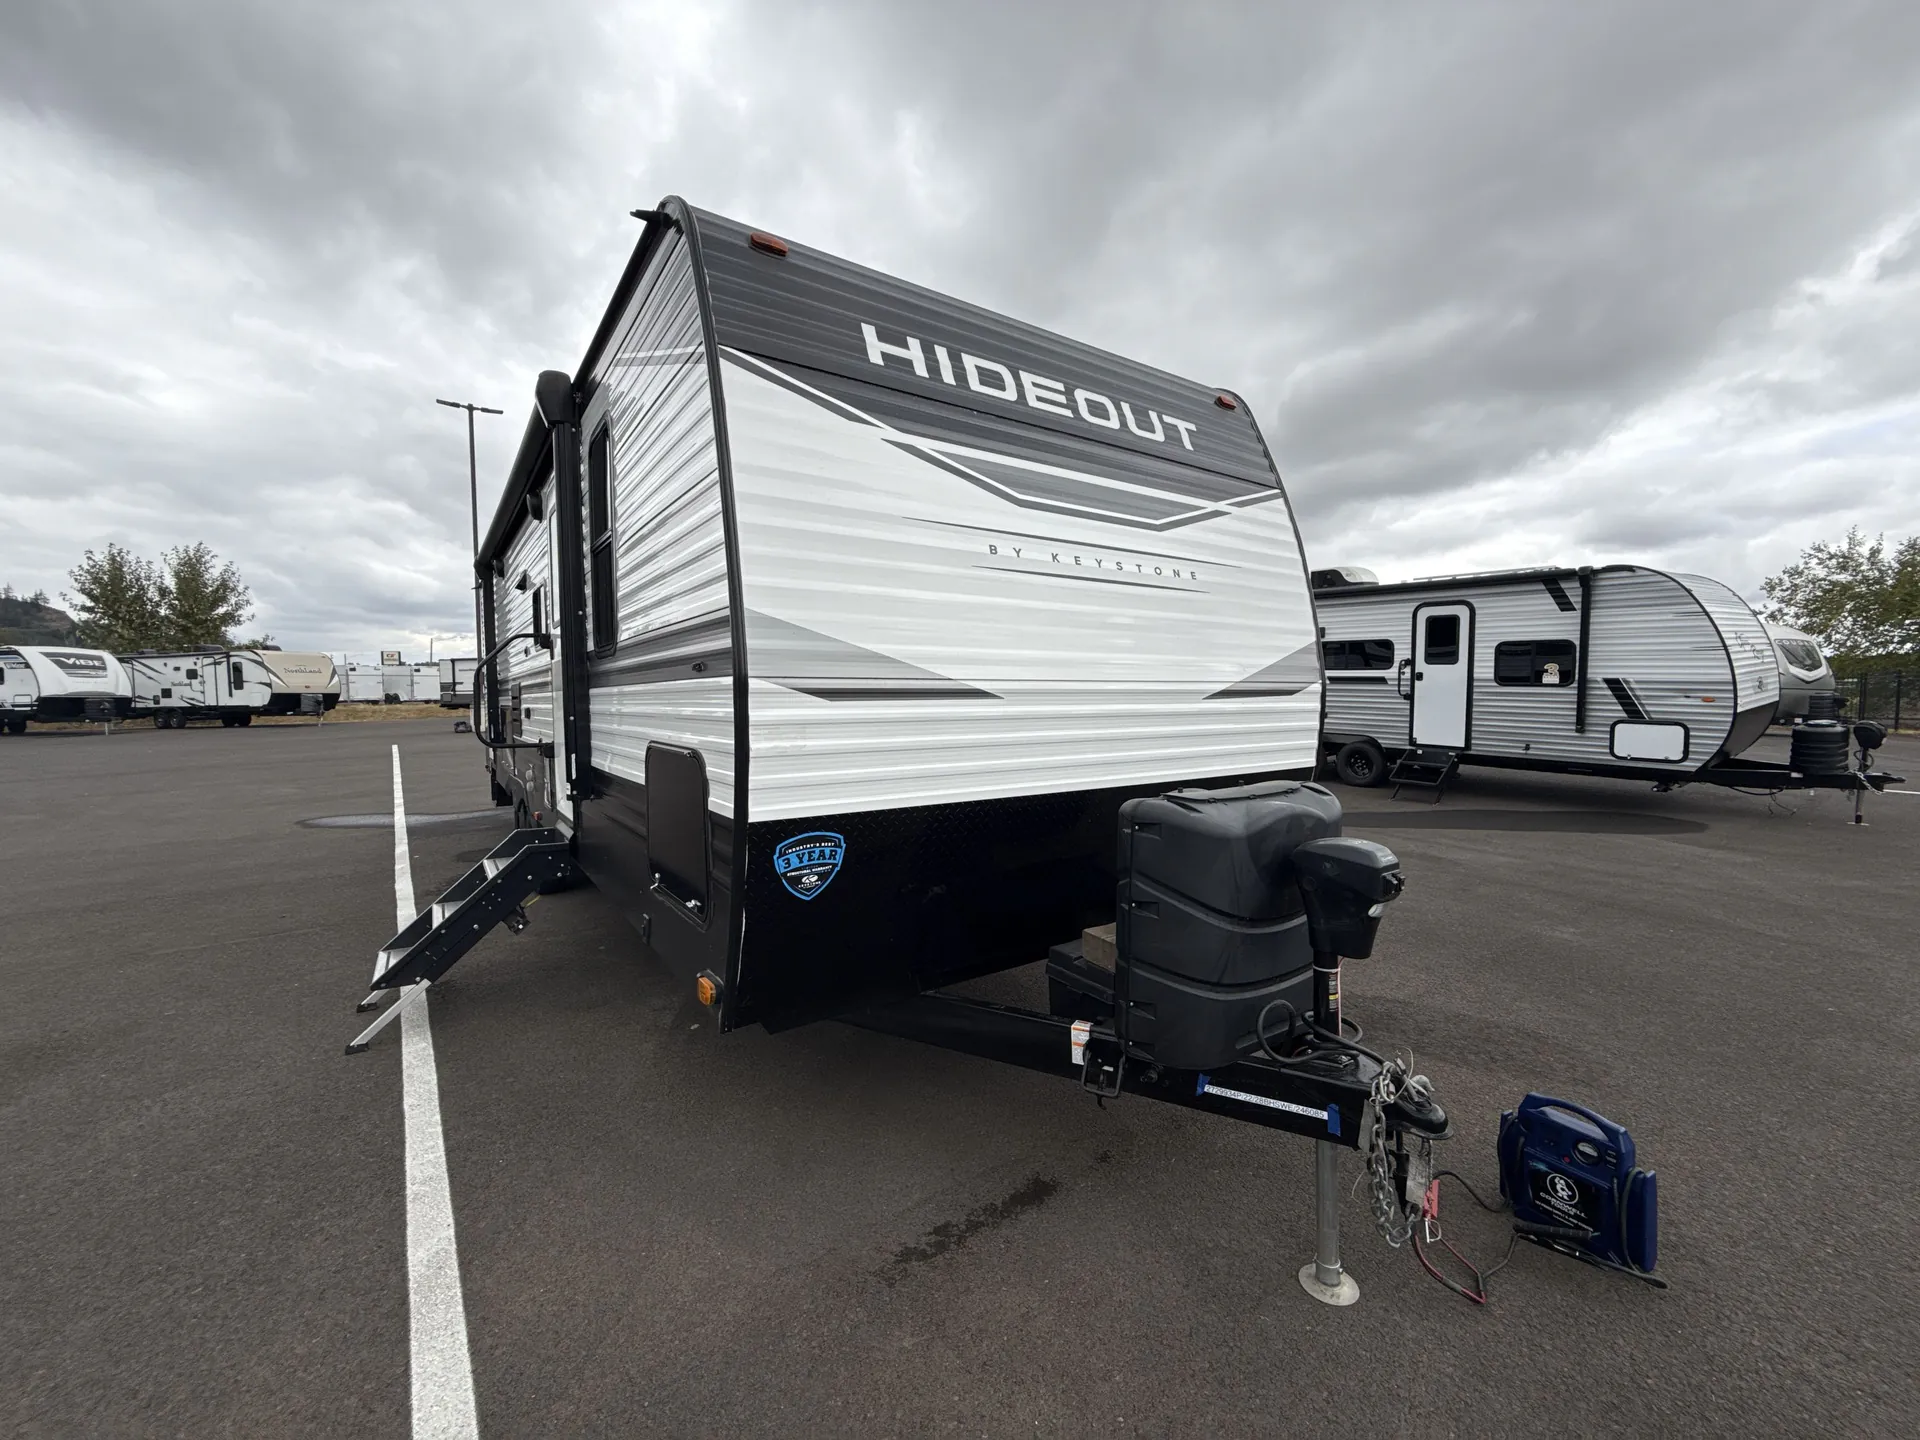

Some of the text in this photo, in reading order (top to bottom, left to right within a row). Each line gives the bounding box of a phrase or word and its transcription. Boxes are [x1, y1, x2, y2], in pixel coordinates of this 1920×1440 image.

[860, 322, 1197, 452] HIDEOUT
[988, 544, 1197, 581] BY KEYSTONE
[782, 857, 791, 869] 3
[795, 849, 837, 864] YEAR
[1539, 1192, 1587, 1219] CORNWELL
